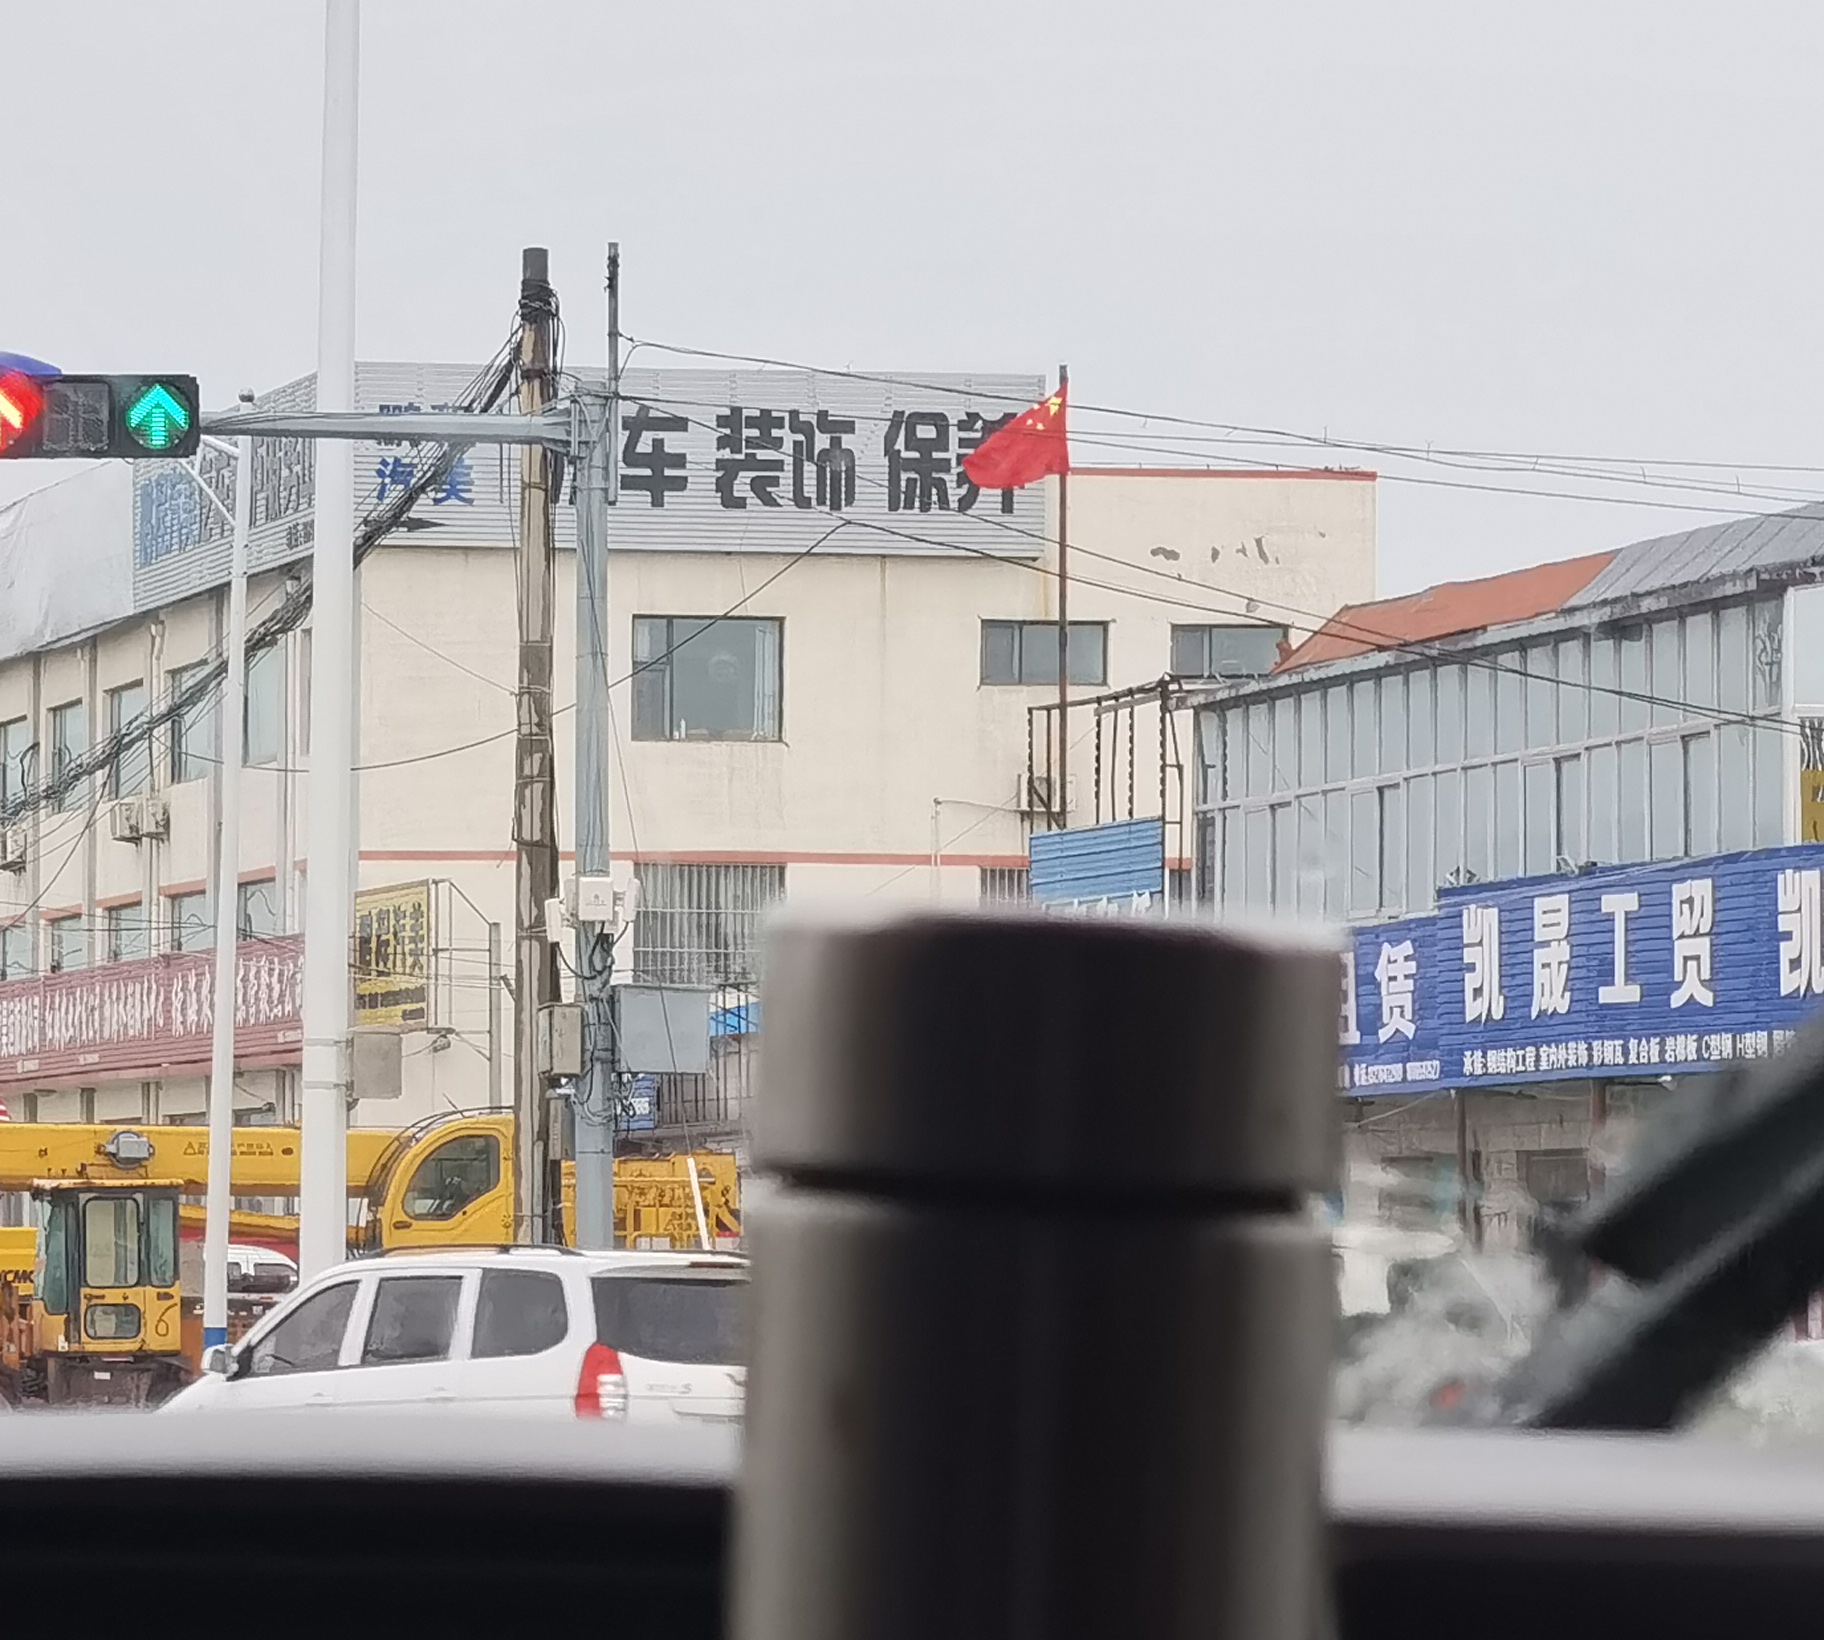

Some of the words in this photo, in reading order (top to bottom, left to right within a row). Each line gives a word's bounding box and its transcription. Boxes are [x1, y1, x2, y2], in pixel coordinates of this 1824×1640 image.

[716, 407, 856, 511] 装饰
[1462, 877, 1714, 1025] 凯晟工贸
[1628, 1037, 1661, 1065] 复合板
